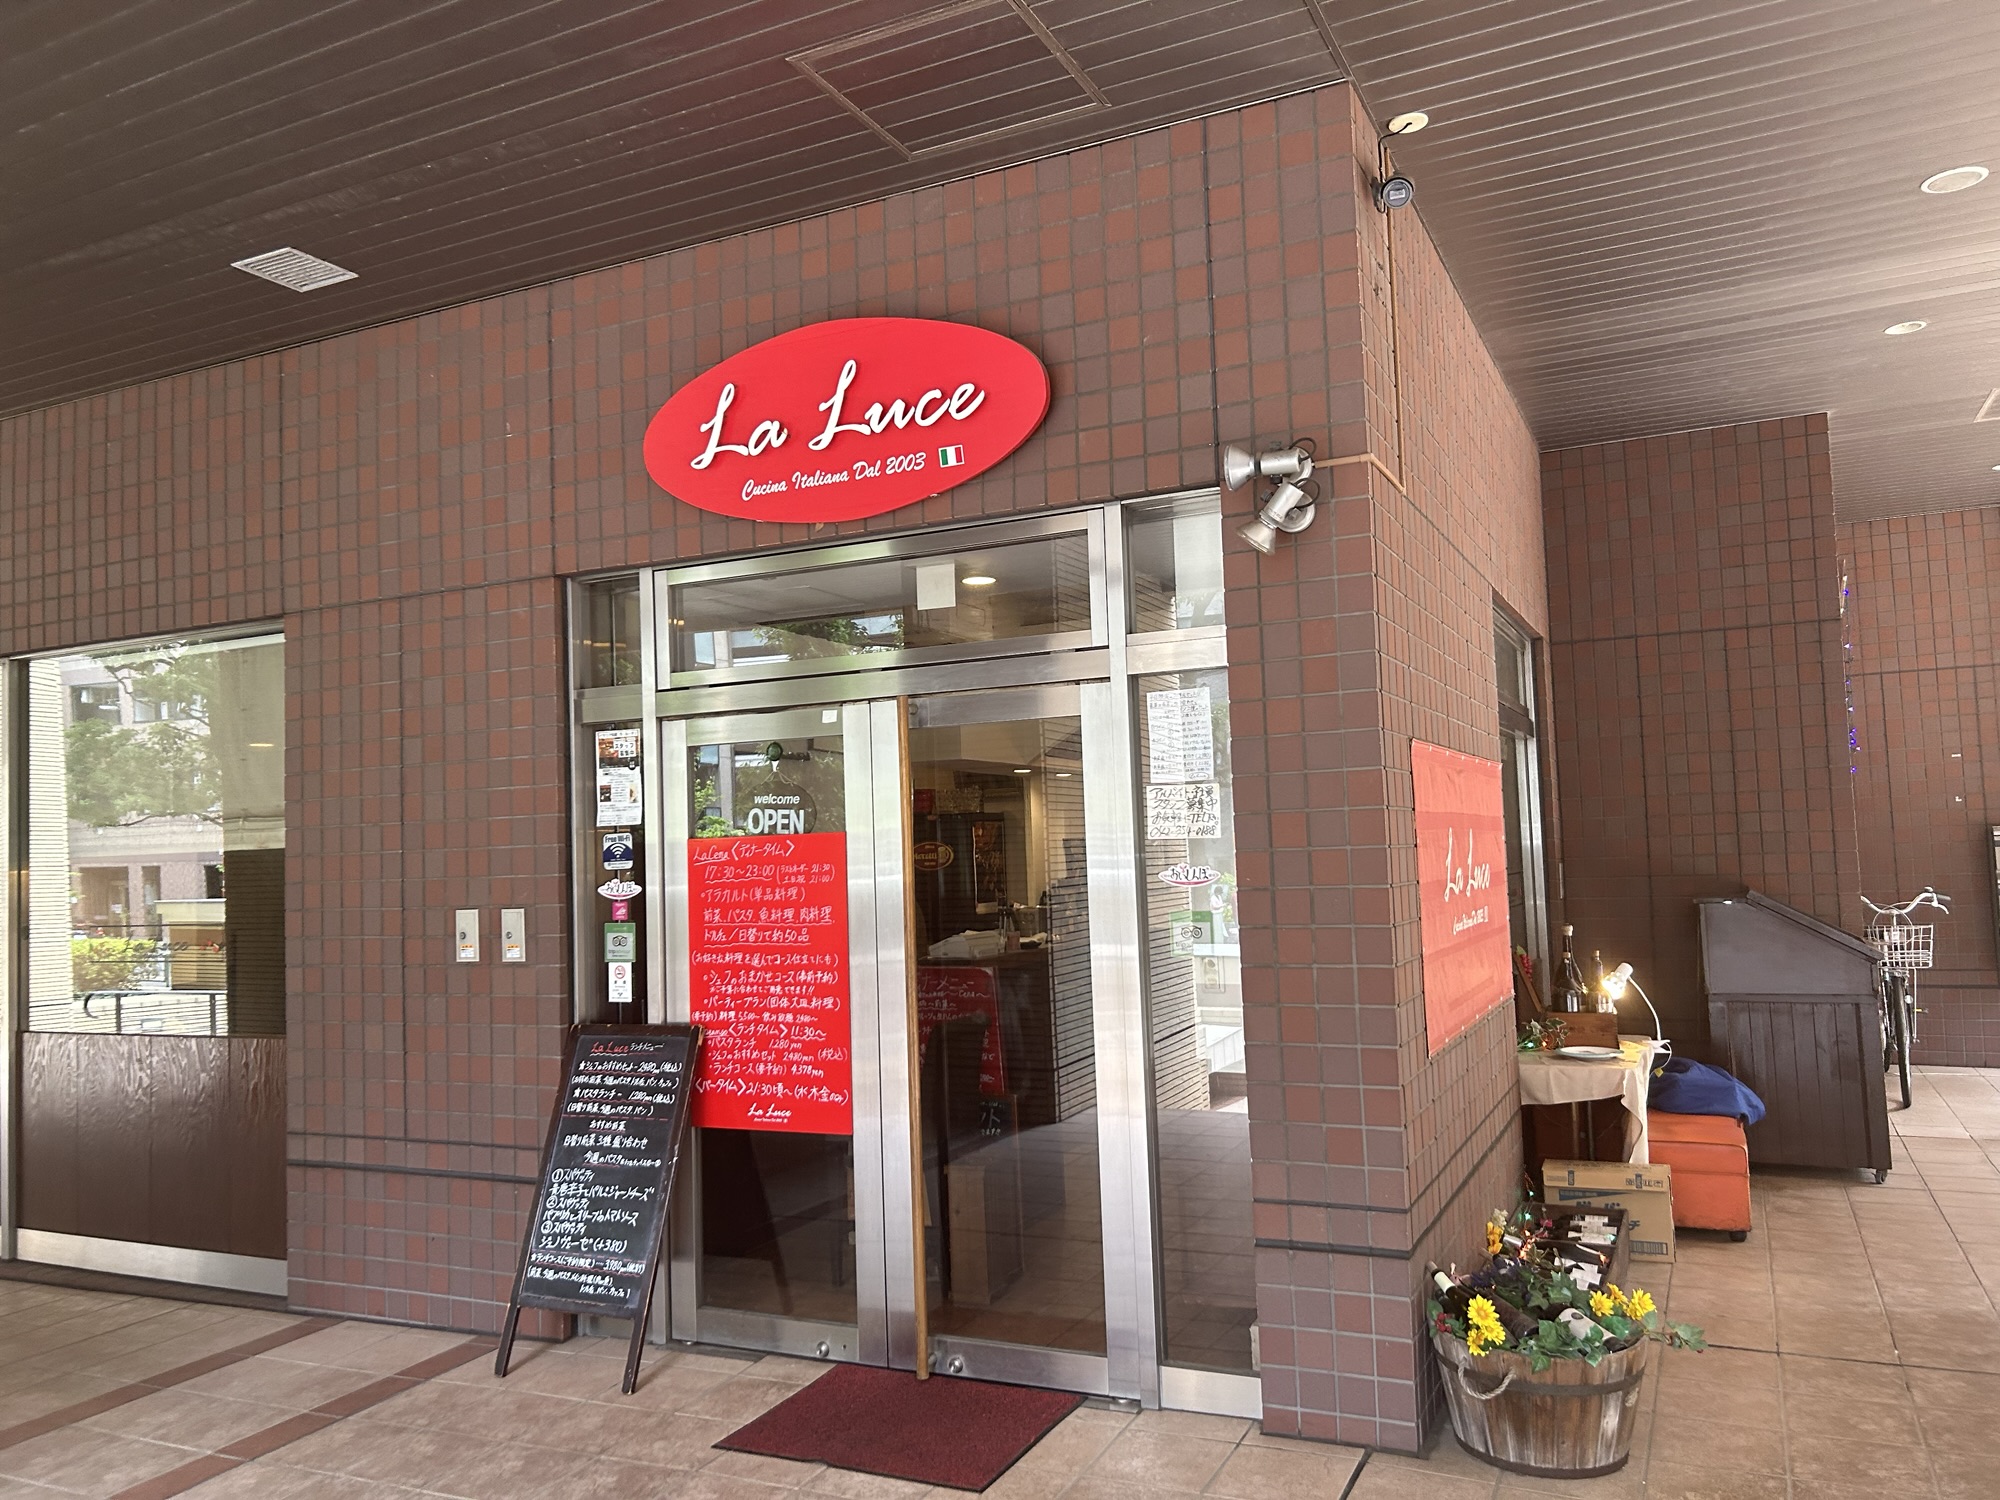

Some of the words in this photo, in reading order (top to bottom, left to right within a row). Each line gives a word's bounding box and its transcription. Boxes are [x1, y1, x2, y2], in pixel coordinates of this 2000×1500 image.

[690, 382, 788, 470] La
[807, 359, 985, 451] Luce
[741, 479, 788, 502] Cucina
[791, 469, 850, 491] Italiana
[852, 460, 882, 481] Dal
[885, 451, 926, 473] 2003
[754, 794, 800, 804] welcome
[747, 808, 805, 834] OPEN
[605, 836, 617, 848] Free
[1444, 827, 1463, 902] La
[1466, 828, 1491, 897] Luce
[591, 1041, 605, 1053] La
[606, 1042, 629, 1054] Luce
[748, 1103, 763, 1116] La
[765, 1103, 792, 1117] Luce
